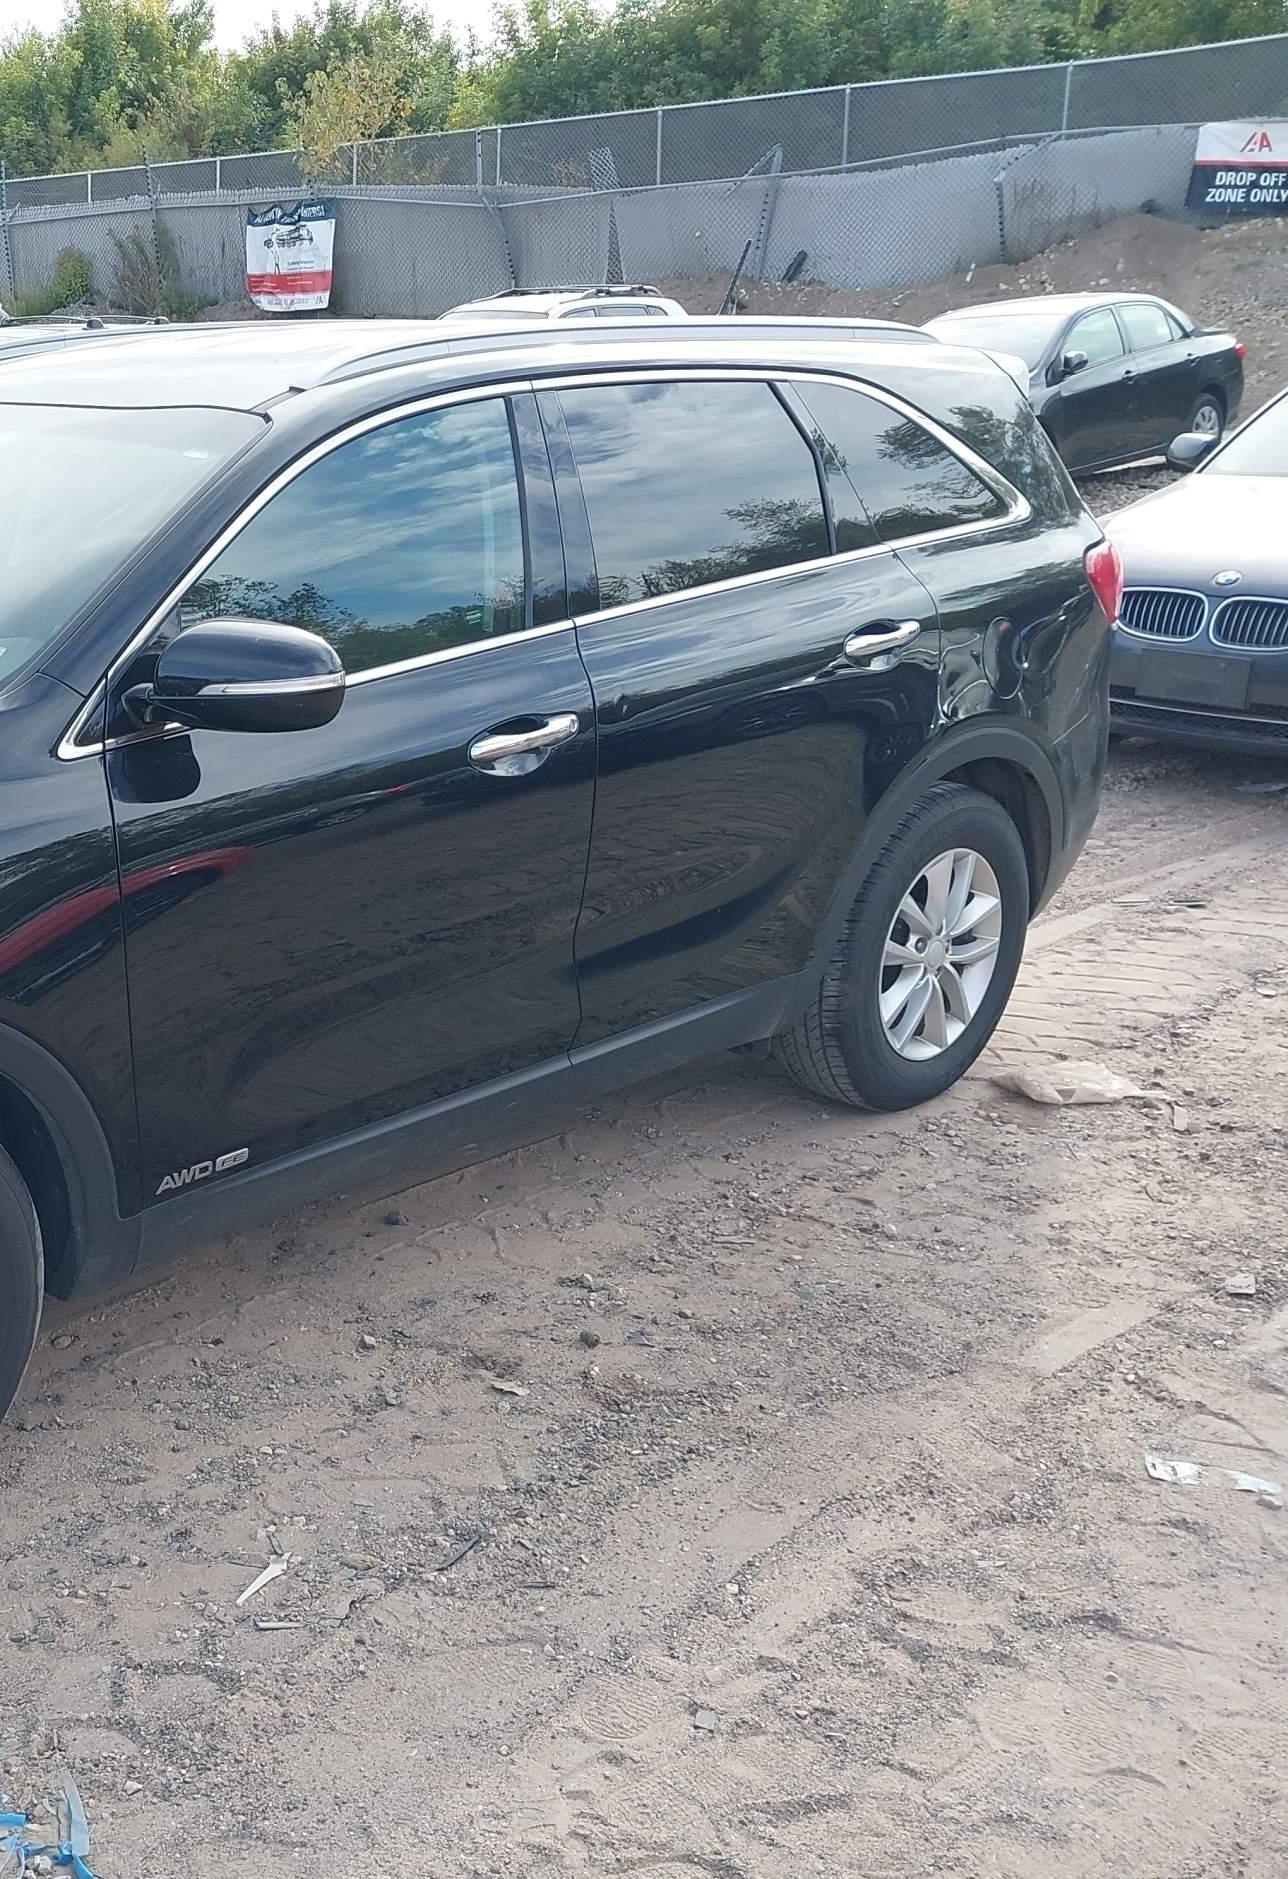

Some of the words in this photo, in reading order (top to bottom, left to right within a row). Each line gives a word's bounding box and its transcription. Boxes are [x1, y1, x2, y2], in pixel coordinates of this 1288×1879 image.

[1215, 171, 1257, 186] DROP
[1259, 172, 1288, 186] OFF
[1204, 188, 1247, 203] ZONE
[1249, 188, 1288, 203] ONLY
[154, 1160, 214, 1196] AWD
